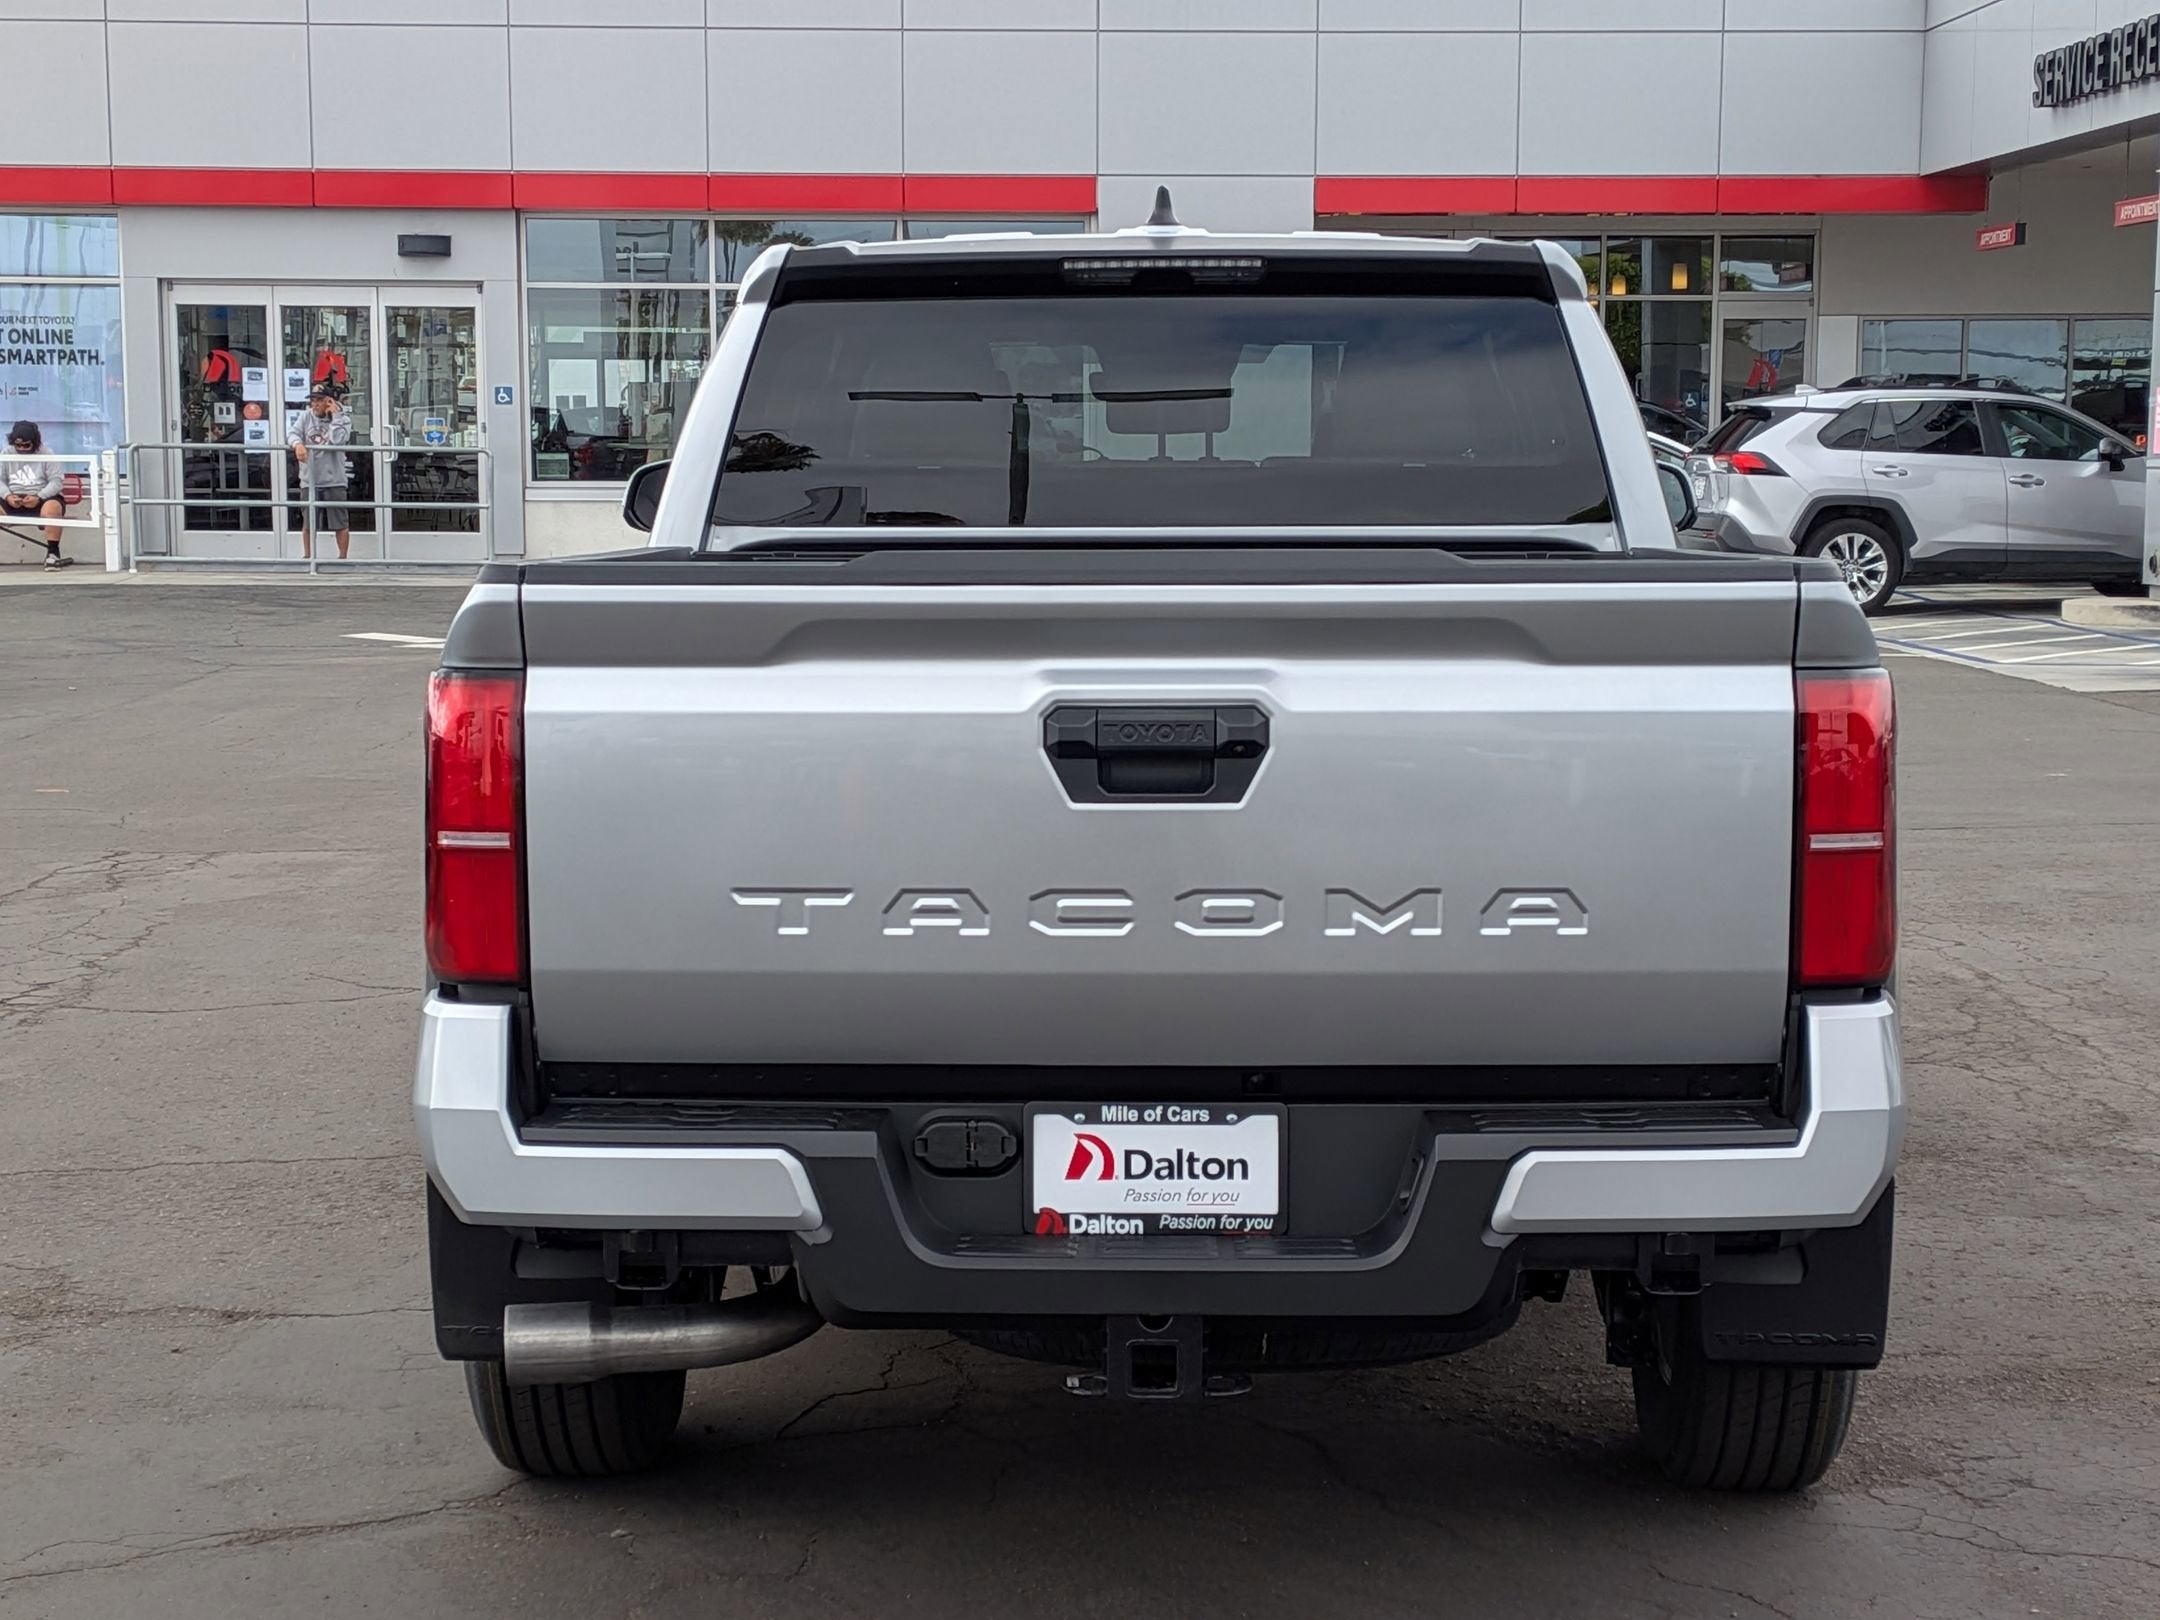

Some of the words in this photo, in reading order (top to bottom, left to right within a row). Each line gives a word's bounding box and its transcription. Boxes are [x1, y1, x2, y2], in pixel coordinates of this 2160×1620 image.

[2032, 33, 2106, 108] SERVICE
[2108, 13, 2160, 88] RECE
[0, 316, 14, 325] UR
[15, 316, 37, 325] NEXT
[8, 328, 74, 345] ONLINE
[0, 348, 105, 366] SMARTPATH.
[1103, 723, 1209, 742] TOYOTA
[731, 886, 1589, 937] TACOMA
[1101, 1105, 1138, 1122] Mile
[1143, 1105, 1162, 1122] of
[1167, 1106, 1210, 1122] Cars
[1124, 1148, 1249, 1181] Dalton
[1123, 1188, 1182, 1203] Passion
[1185, 1187, 1208, 1205] for
[1211, 1193, 1240, 1206] you
[1069, 1214, 1144, 1235] Dalton
[1159, 1214, 1216, 1231] Passion
[1220, 1214, 1241, 1231] for
[1245, 1217, 1274, 1232] you
